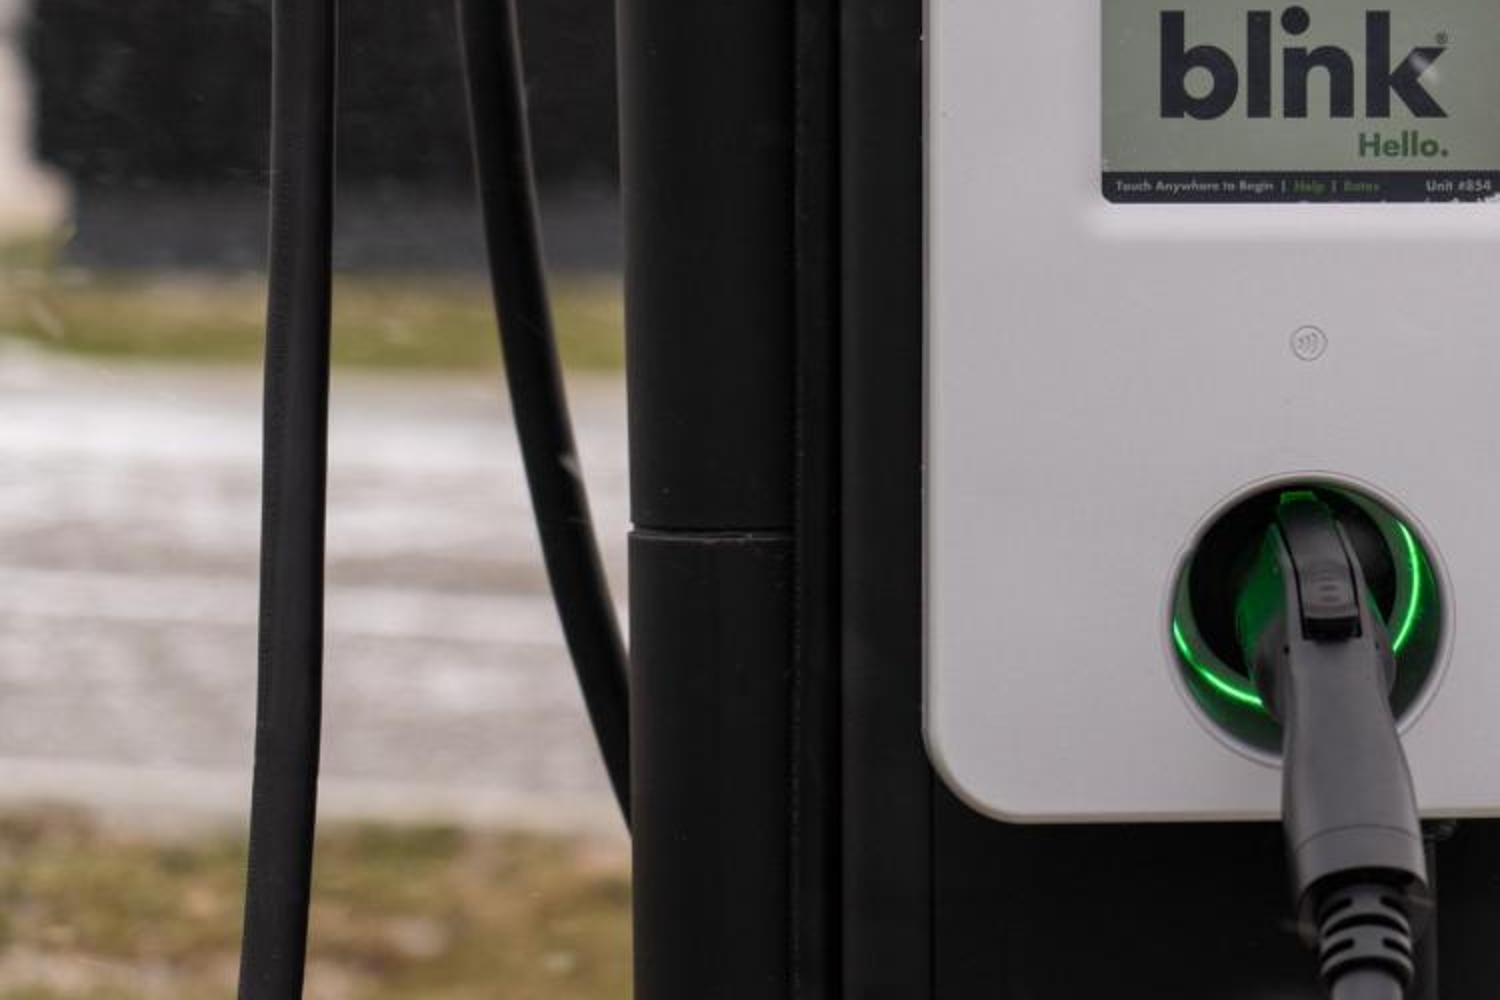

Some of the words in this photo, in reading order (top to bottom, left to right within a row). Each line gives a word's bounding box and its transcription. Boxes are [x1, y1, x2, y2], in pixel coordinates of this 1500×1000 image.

[1159, 5, 1449, 121] blink
[1358, 130, 1449, 158] Hello.
[1116, 180, 1151, 193] Touch
[1155, 179, 1221, 194] Anywhere
[1223, 180, 1236, 193] to
[1239, 180, 1275, 194] Begin
[1426, 179, 1454, 192] Unit
[1457, 179, 1492, 192] #854
